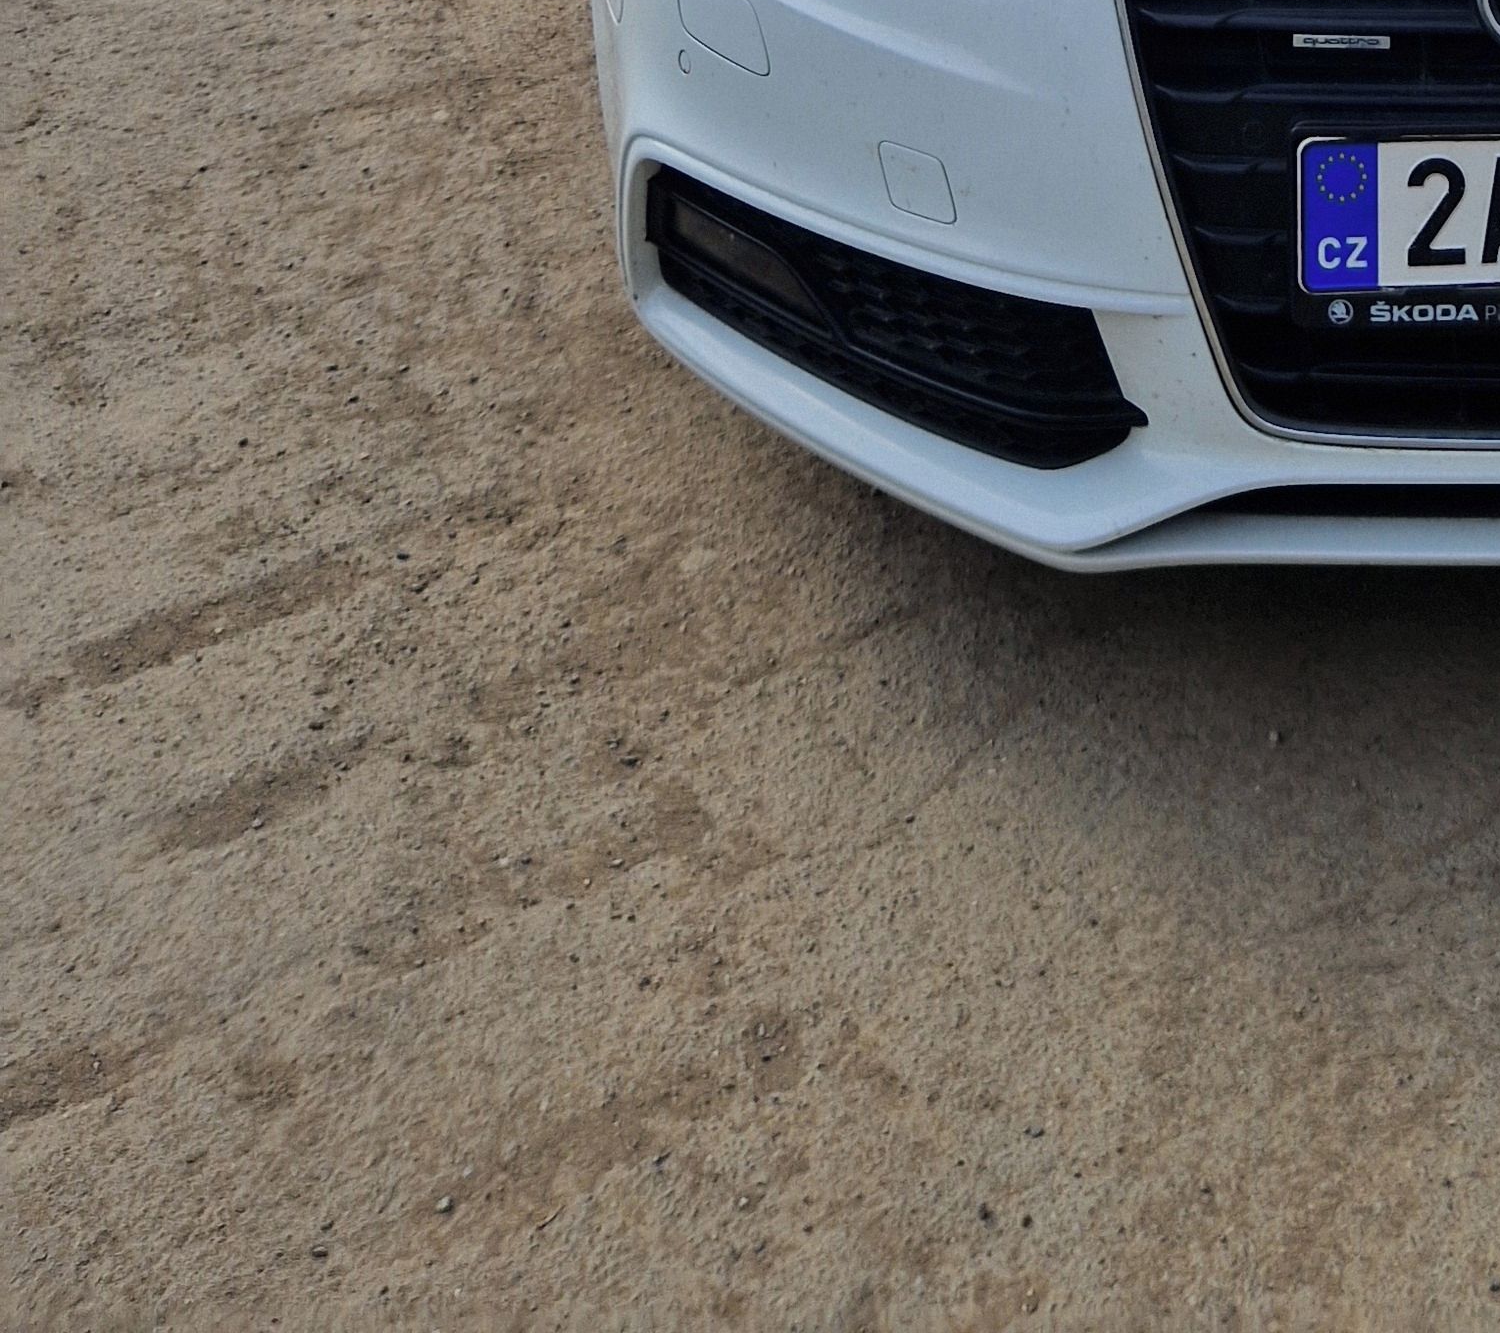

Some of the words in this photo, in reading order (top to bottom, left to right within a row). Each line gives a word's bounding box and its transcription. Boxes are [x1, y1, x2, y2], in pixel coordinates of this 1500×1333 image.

[1303, 37, 1380, 46] quattro
[1317, 237, 1368, 269] CZ
[1370, 301, 1479, 322] ŠKODA
